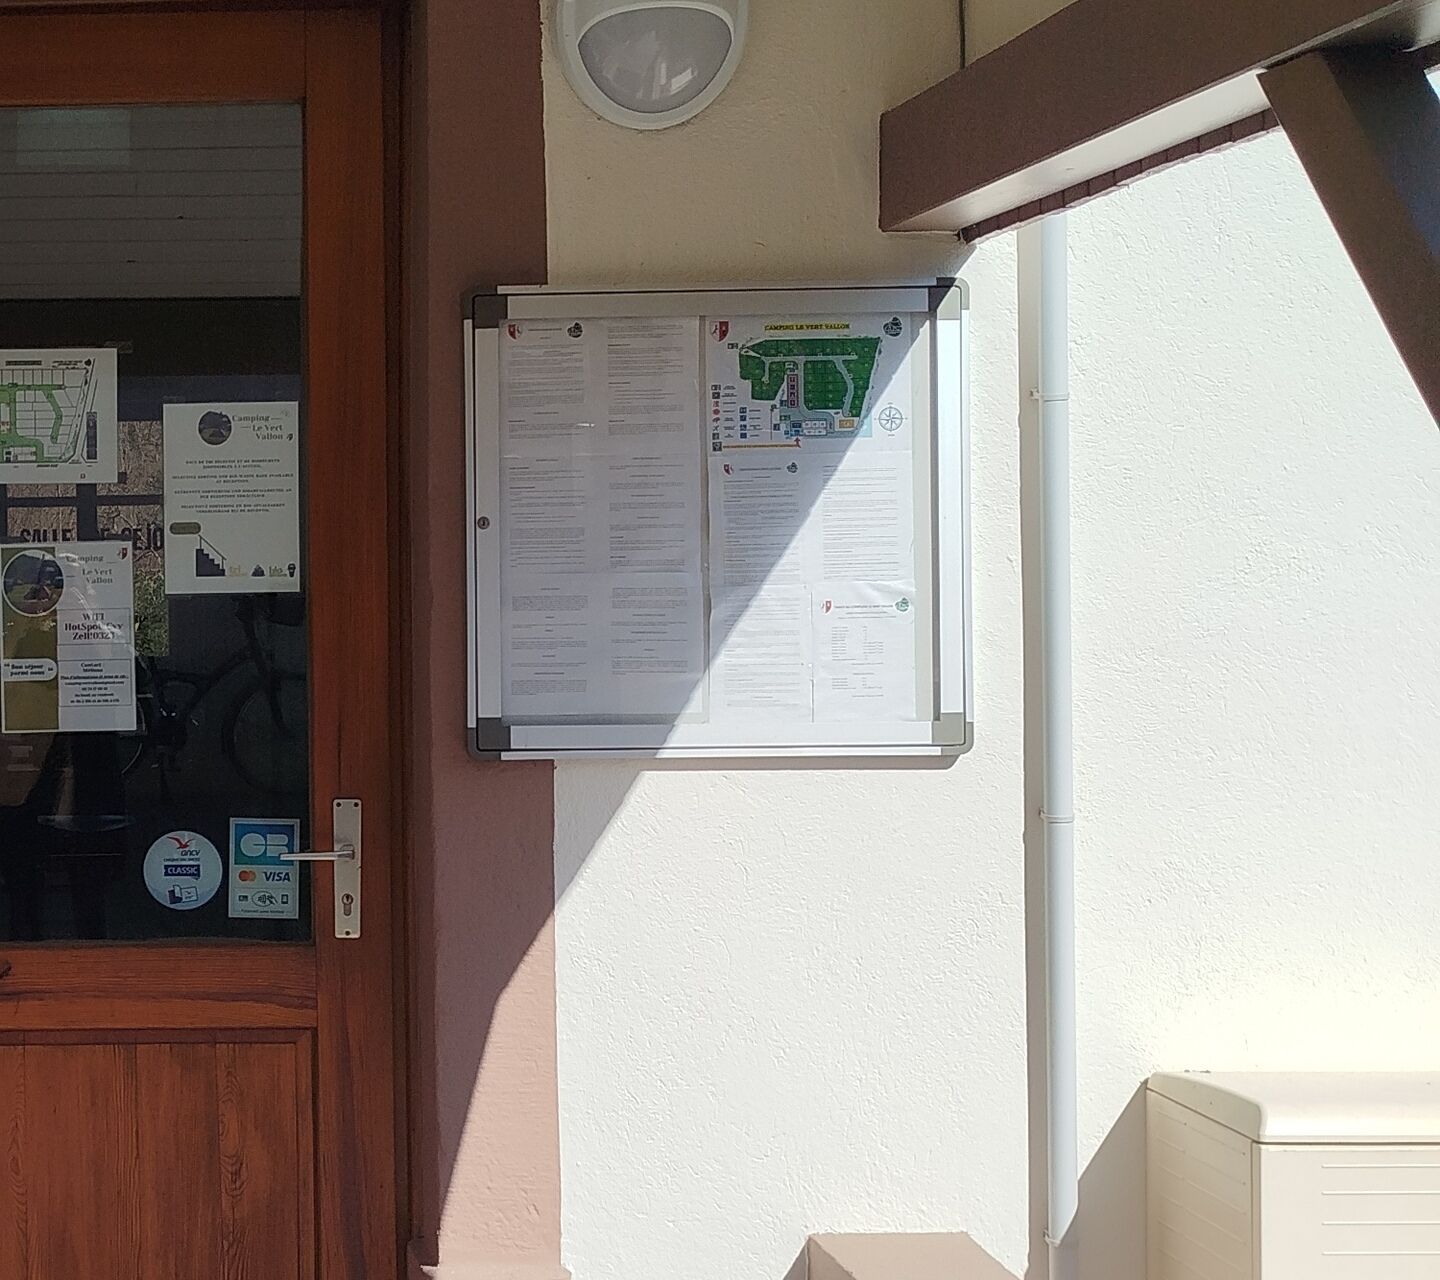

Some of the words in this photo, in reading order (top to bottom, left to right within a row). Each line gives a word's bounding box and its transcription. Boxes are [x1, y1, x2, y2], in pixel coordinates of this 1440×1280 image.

[231, 414, 270, 423] Camping
[86, 576, 113, 584] Vallon
[167, 866, 198, 874] CLASSIC
[263, 871, 291, 882] VISA
